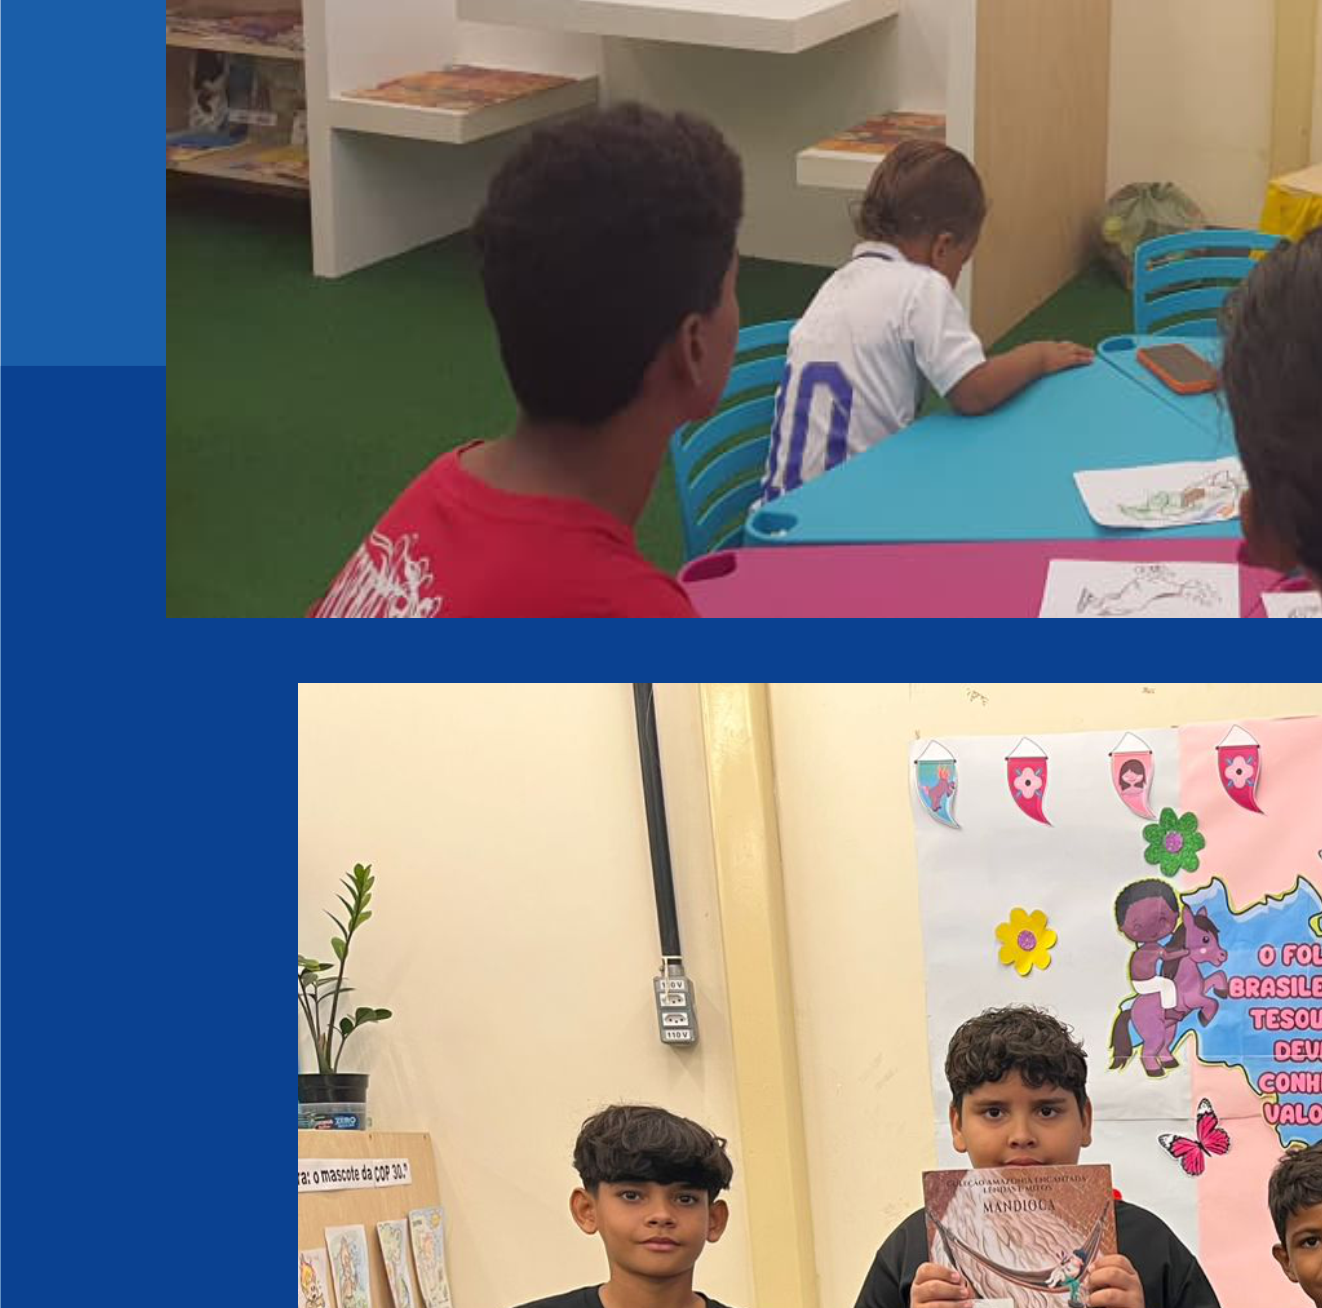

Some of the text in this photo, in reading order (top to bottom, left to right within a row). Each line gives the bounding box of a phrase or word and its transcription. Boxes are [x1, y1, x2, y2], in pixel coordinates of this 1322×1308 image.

[1258, 944, 1276, 967] O
[313, 1171, 320, 1184] o
[320, 1165, 360, 1182] mascote
[362, 1163, 373, 1181] da
[374, 1165, 390, 1182] COP
[983, 1200, 1056, 1214] MANDIOCA
